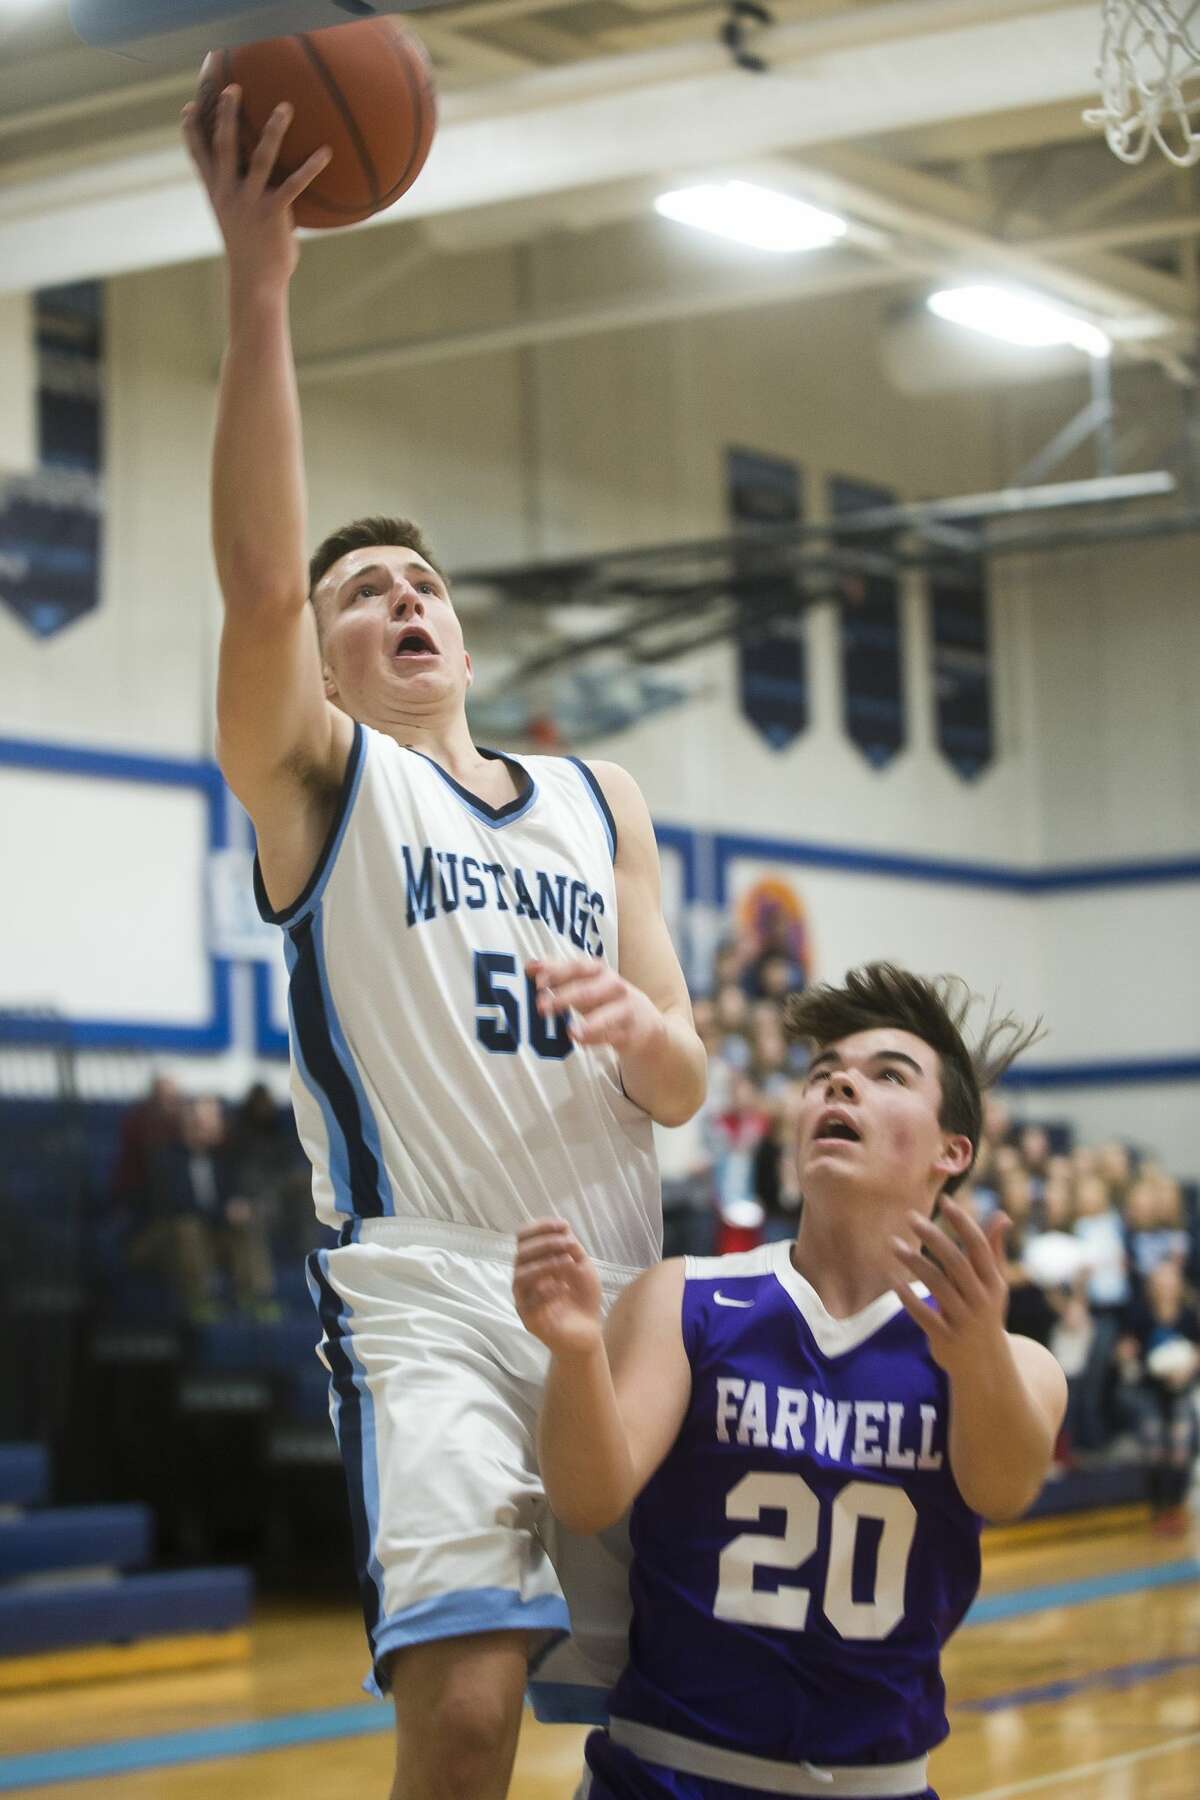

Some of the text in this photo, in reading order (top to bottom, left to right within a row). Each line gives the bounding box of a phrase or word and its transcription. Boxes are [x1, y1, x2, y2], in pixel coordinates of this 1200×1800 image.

[402, 845, 605, 957] MUSTANGS
[716, 1377, 943, 1470] FARWELL
[713, 1471, 918, 1640] 20
